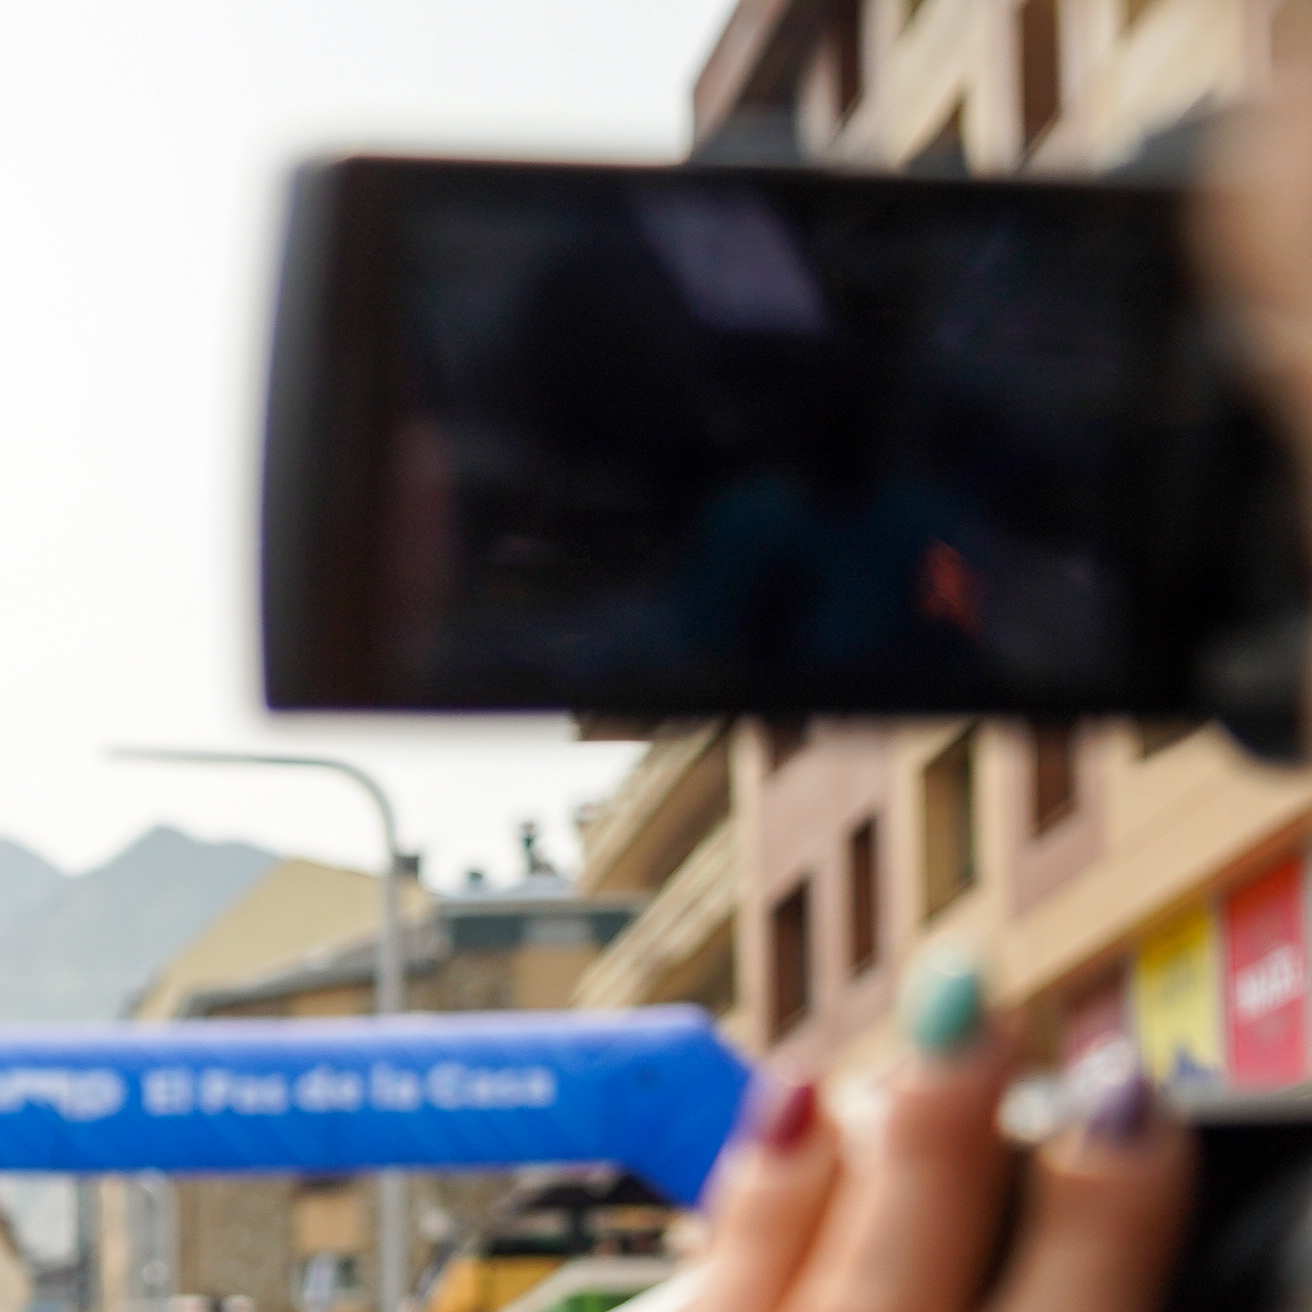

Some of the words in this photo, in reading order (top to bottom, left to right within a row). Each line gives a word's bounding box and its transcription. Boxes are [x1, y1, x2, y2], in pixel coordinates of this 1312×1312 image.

[140, 1066, 193, 1117] El
[294, 1063, 364, 1114] de
[370, 1062, 422, 1114] la
[427, 1060, 557, 1113] Casa
